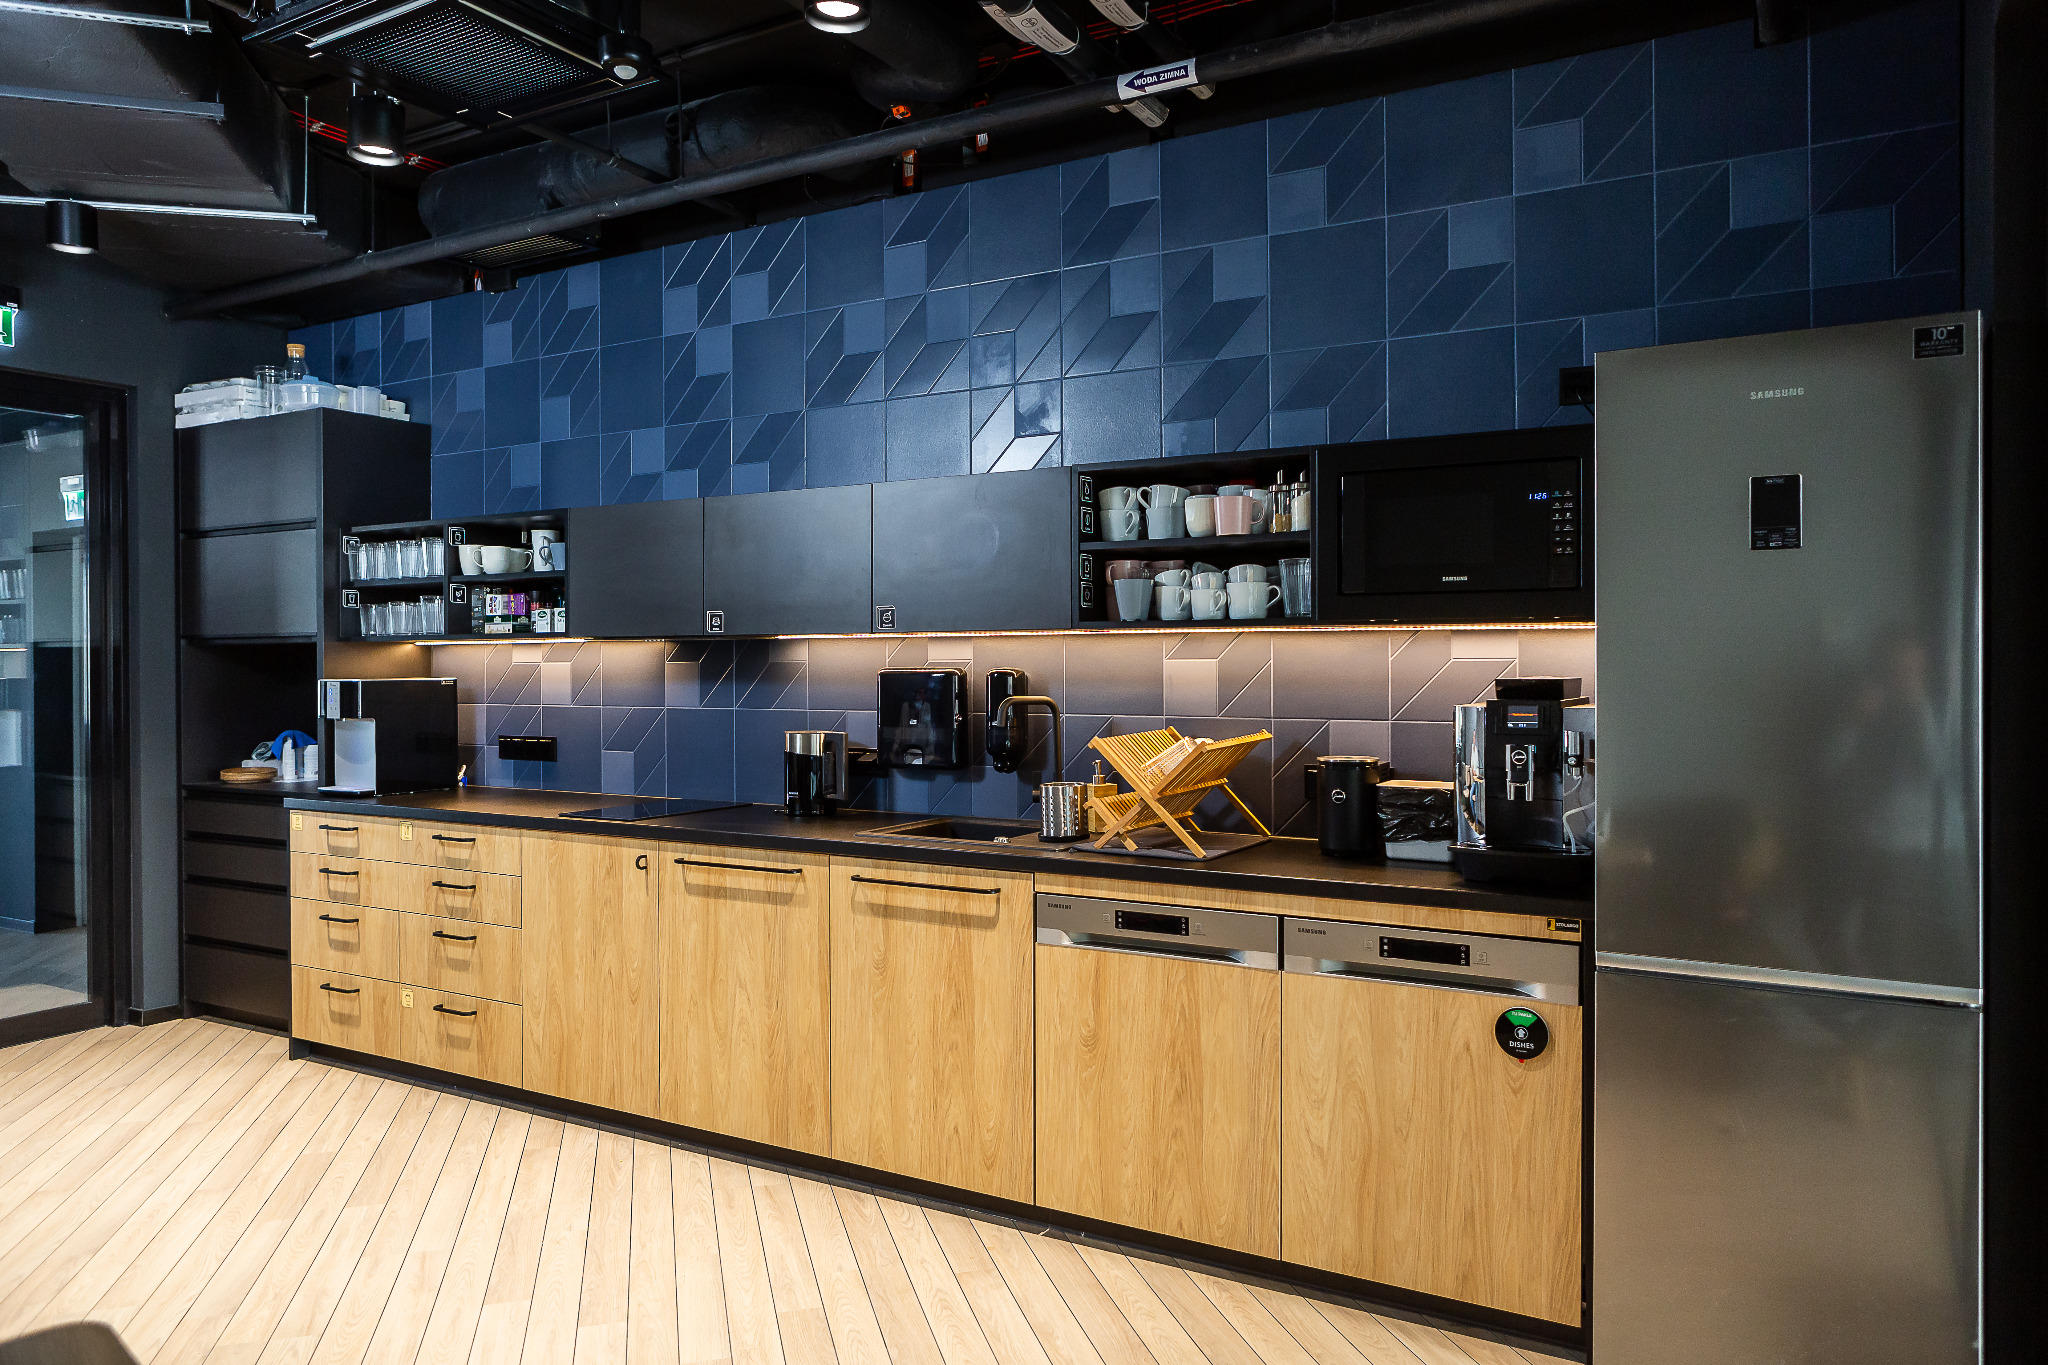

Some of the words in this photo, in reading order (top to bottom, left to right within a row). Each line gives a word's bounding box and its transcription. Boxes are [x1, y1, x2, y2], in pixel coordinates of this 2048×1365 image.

[1134, 75, 1158, 87] WODA
[1159, 68, 1186, 81] ZIMNA
[1931, 327, 1947, 340] 10
[1750, 387, 1805, 400] SAMSUNG
[1047, 902, 1072, 910] SAMSUNG
[1297, 927, 1327, 936] SAMSUNG
[1509, 1040, 1535, 1050] DISHES
